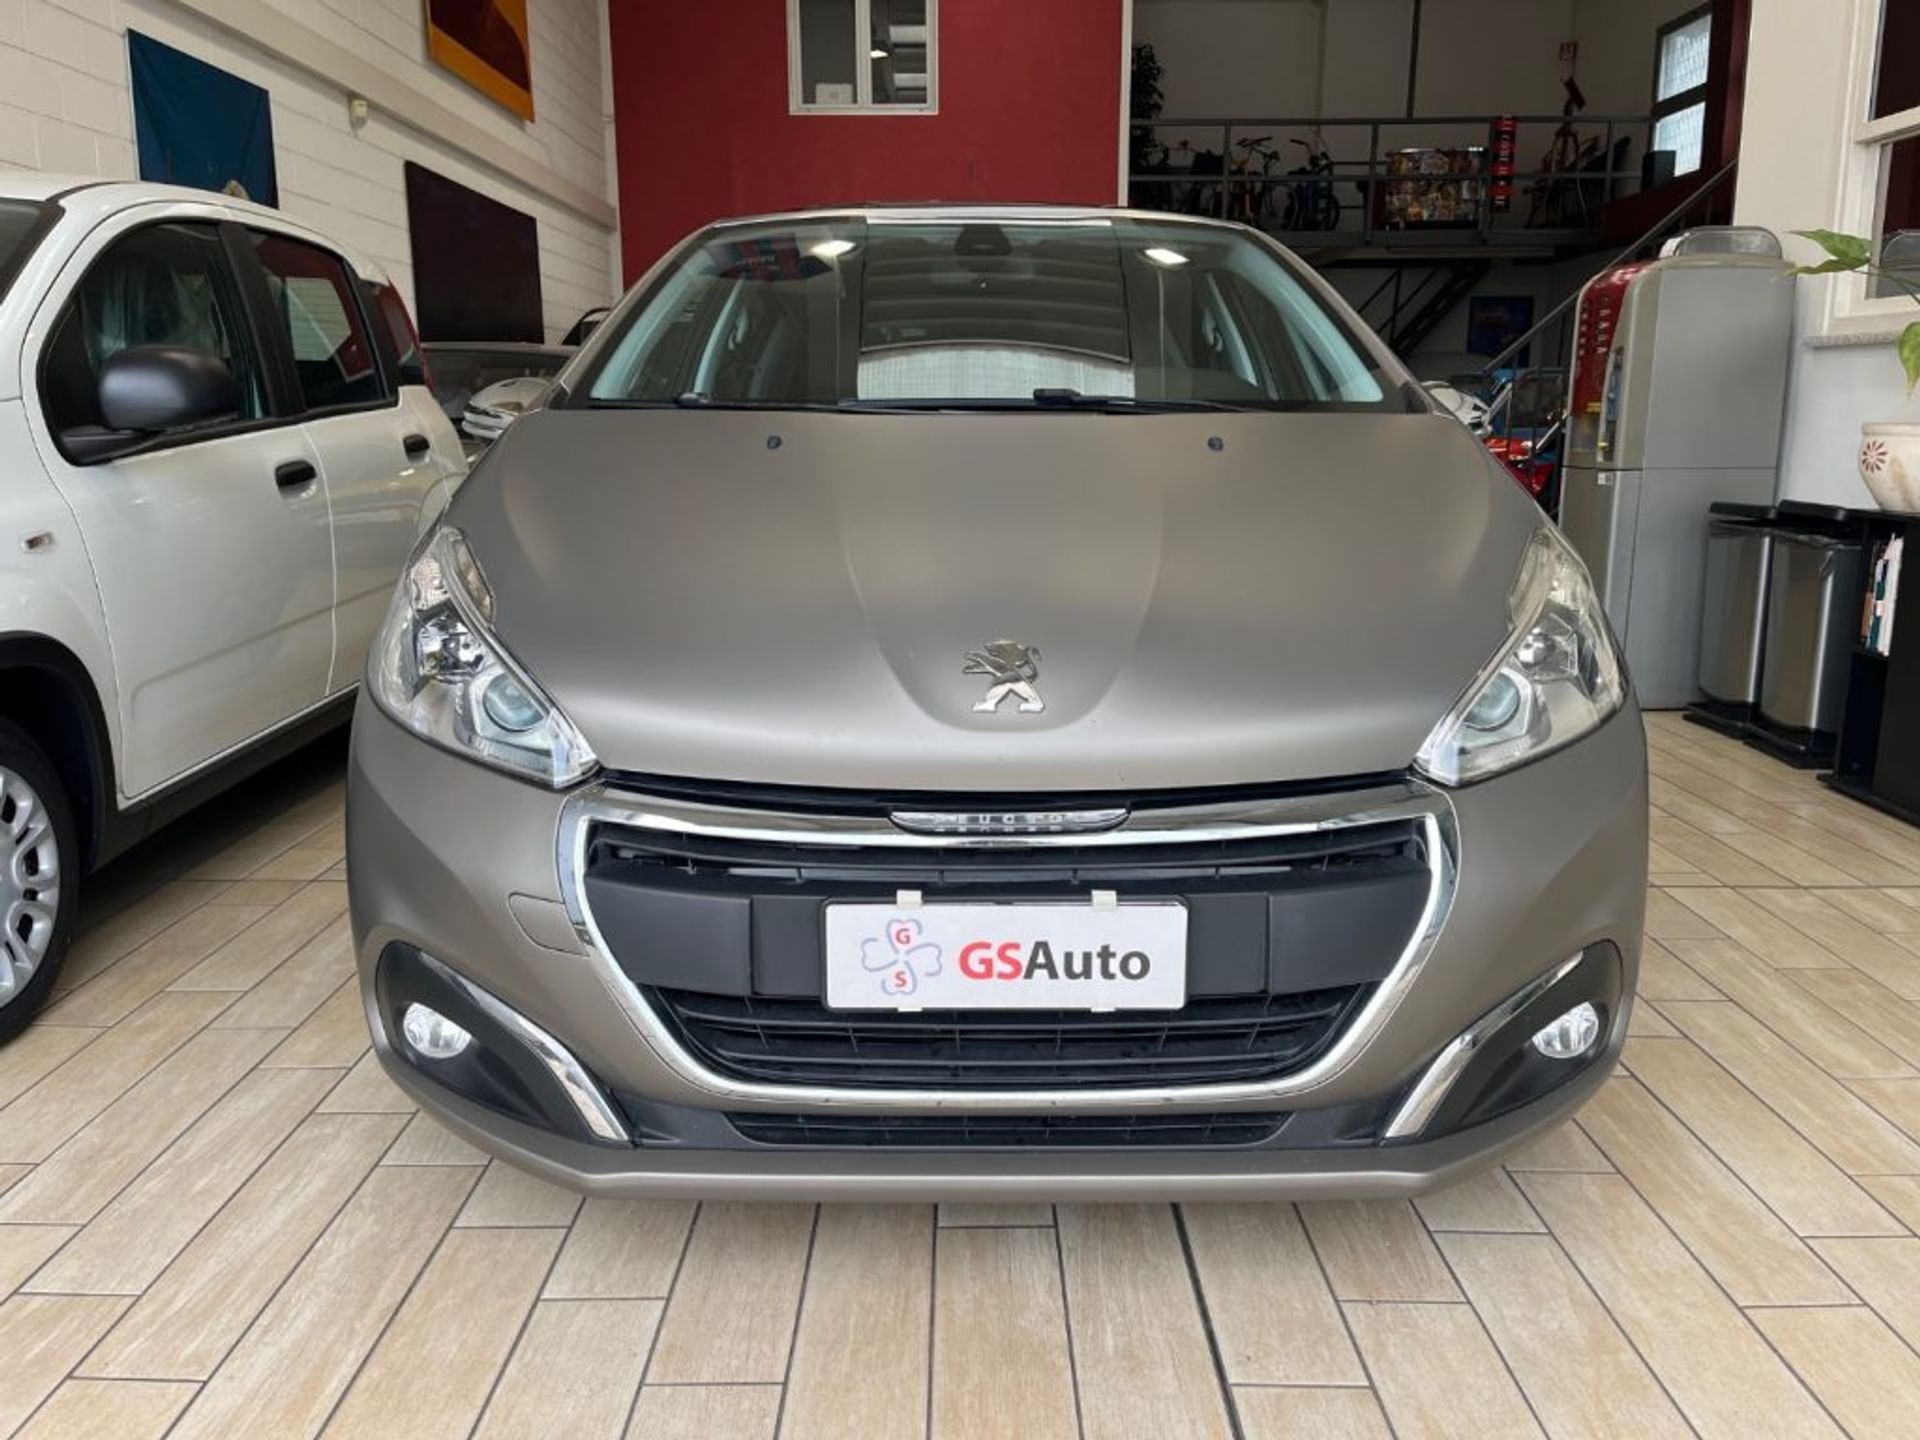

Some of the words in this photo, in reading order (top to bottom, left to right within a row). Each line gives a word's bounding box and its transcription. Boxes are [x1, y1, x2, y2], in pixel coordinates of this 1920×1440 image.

[896, 928, 910, 944] G
[958, 940, 1151, 980] GSAuto
[895, 971, 907, 987] S
